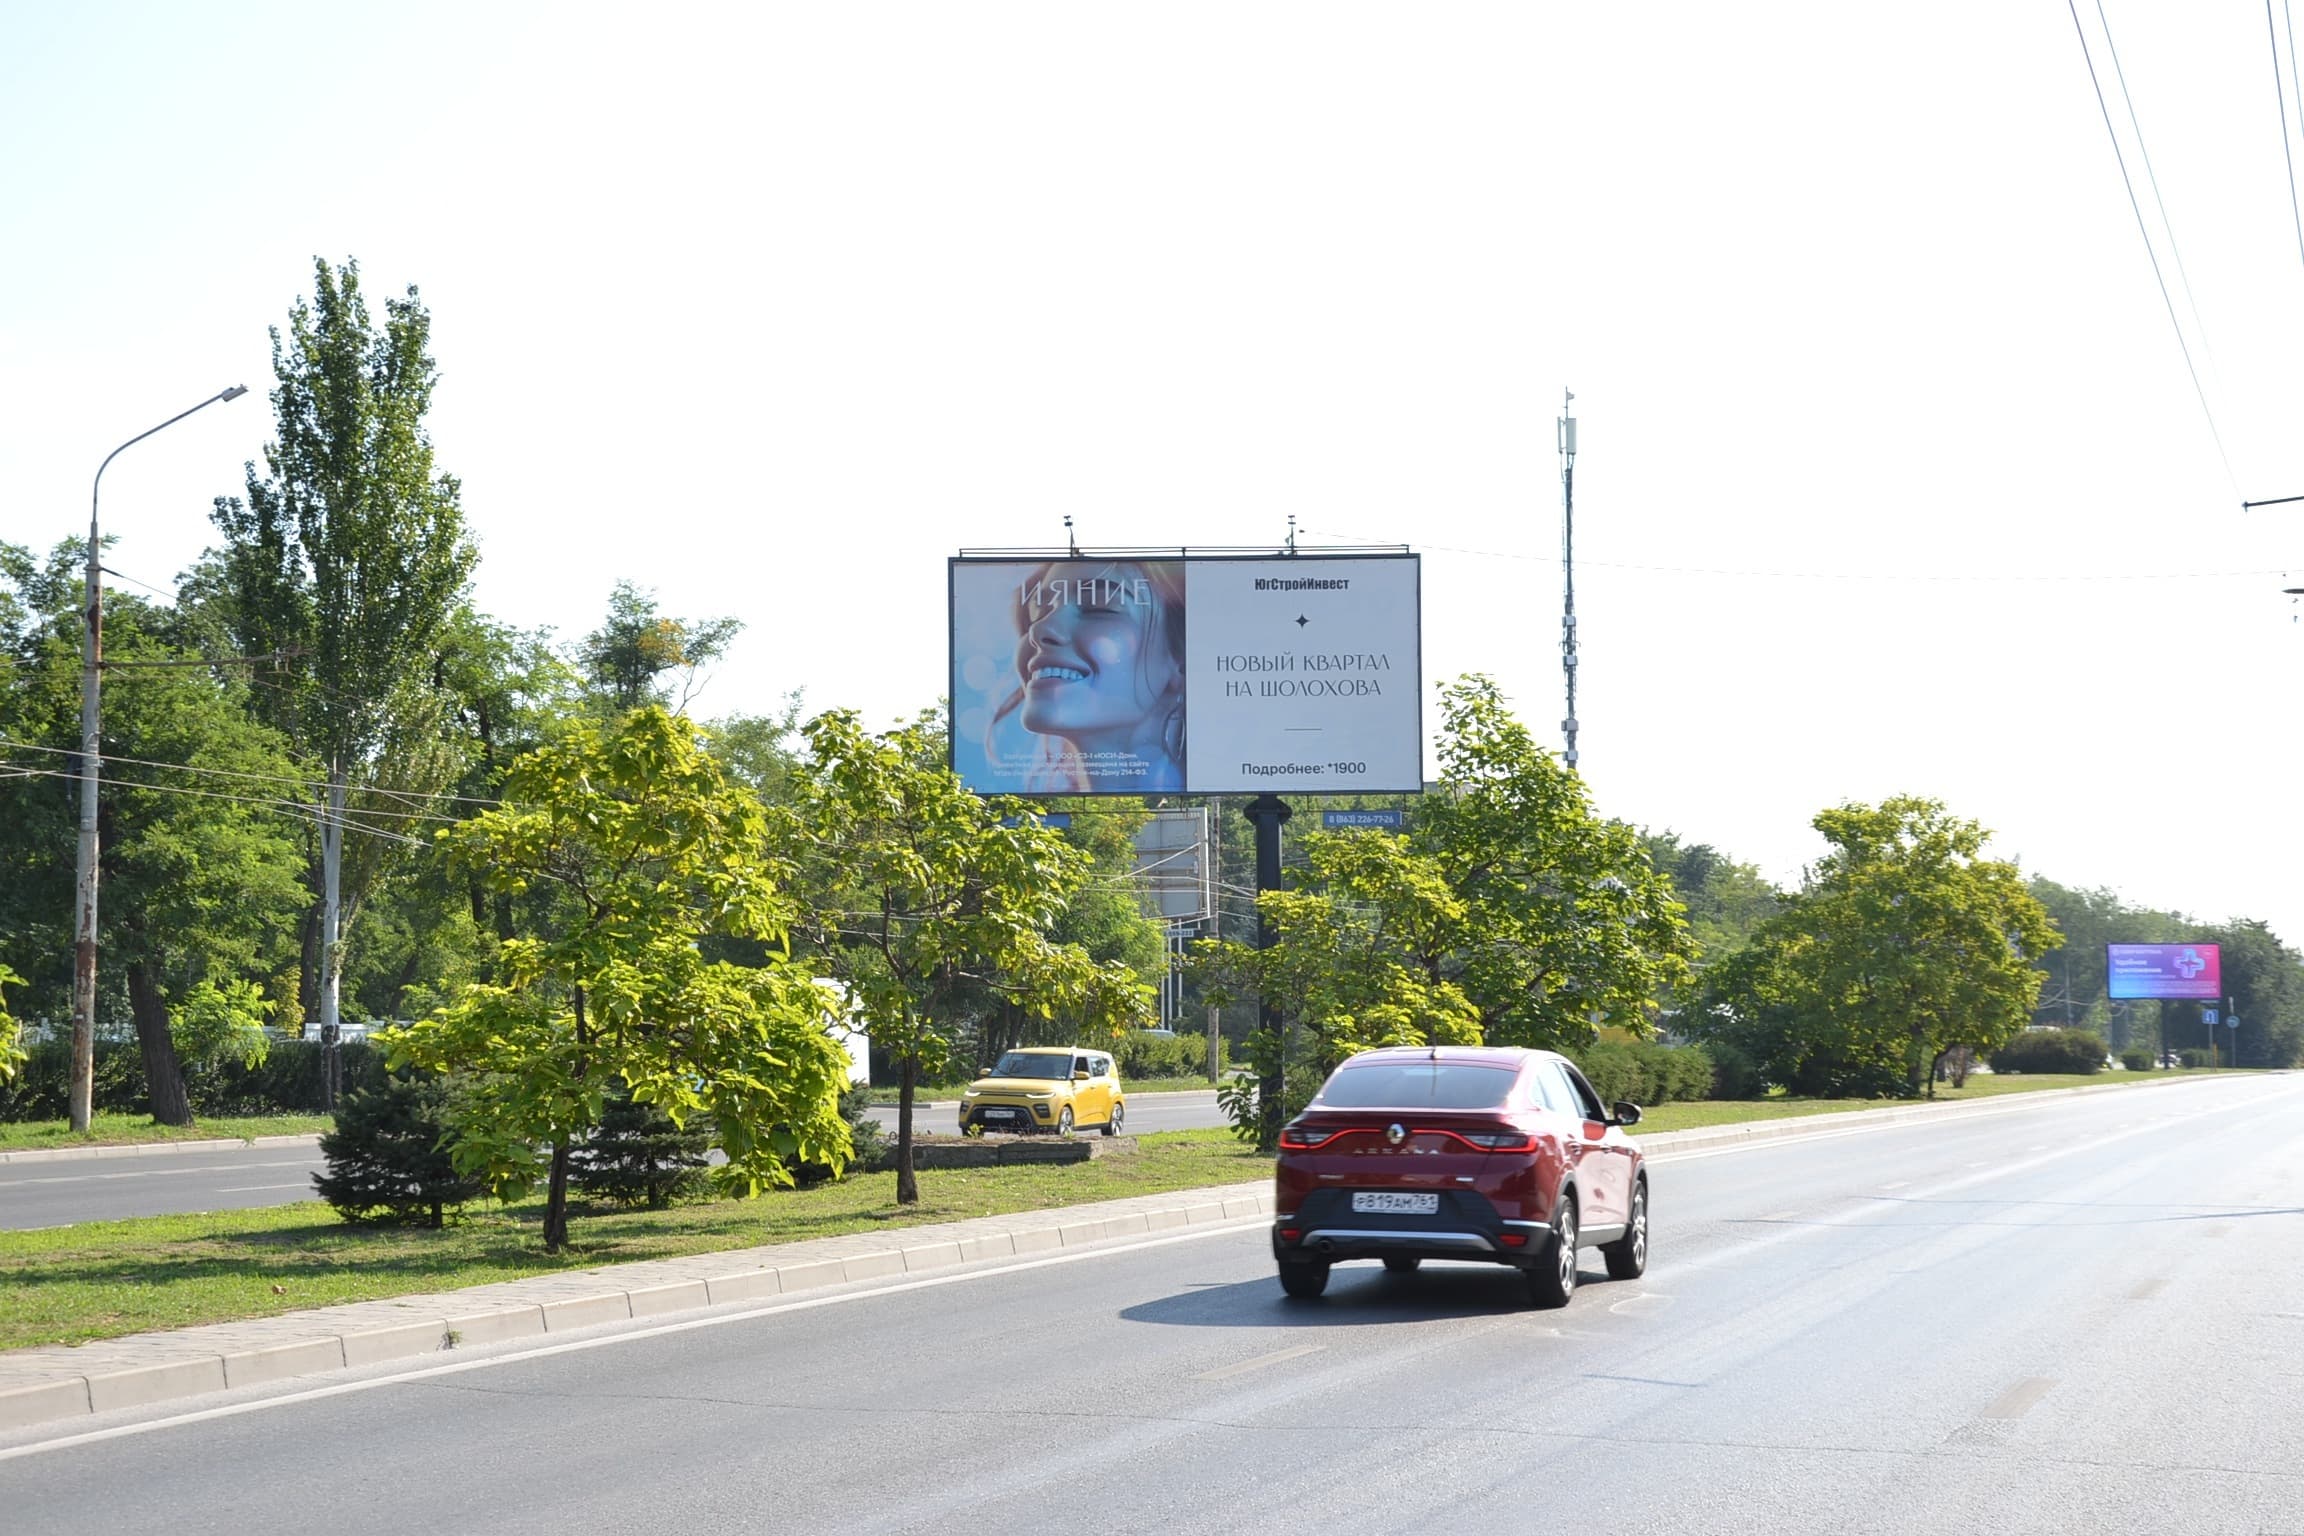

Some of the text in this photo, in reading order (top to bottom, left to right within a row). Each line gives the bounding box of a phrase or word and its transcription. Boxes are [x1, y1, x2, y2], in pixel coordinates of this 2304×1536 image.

[1254, 577, 1350, 592] ЮгСтройИнвест
[1216, 651, 1391, 672] НОВЫЙ КВАРТАЛ
[1226, 679, 1382, 697] НА ШОЛОХОВА
[1241, 763, 1325, 776] Подробнее:
[1357, 815, 1394, 824] 226-77-26
